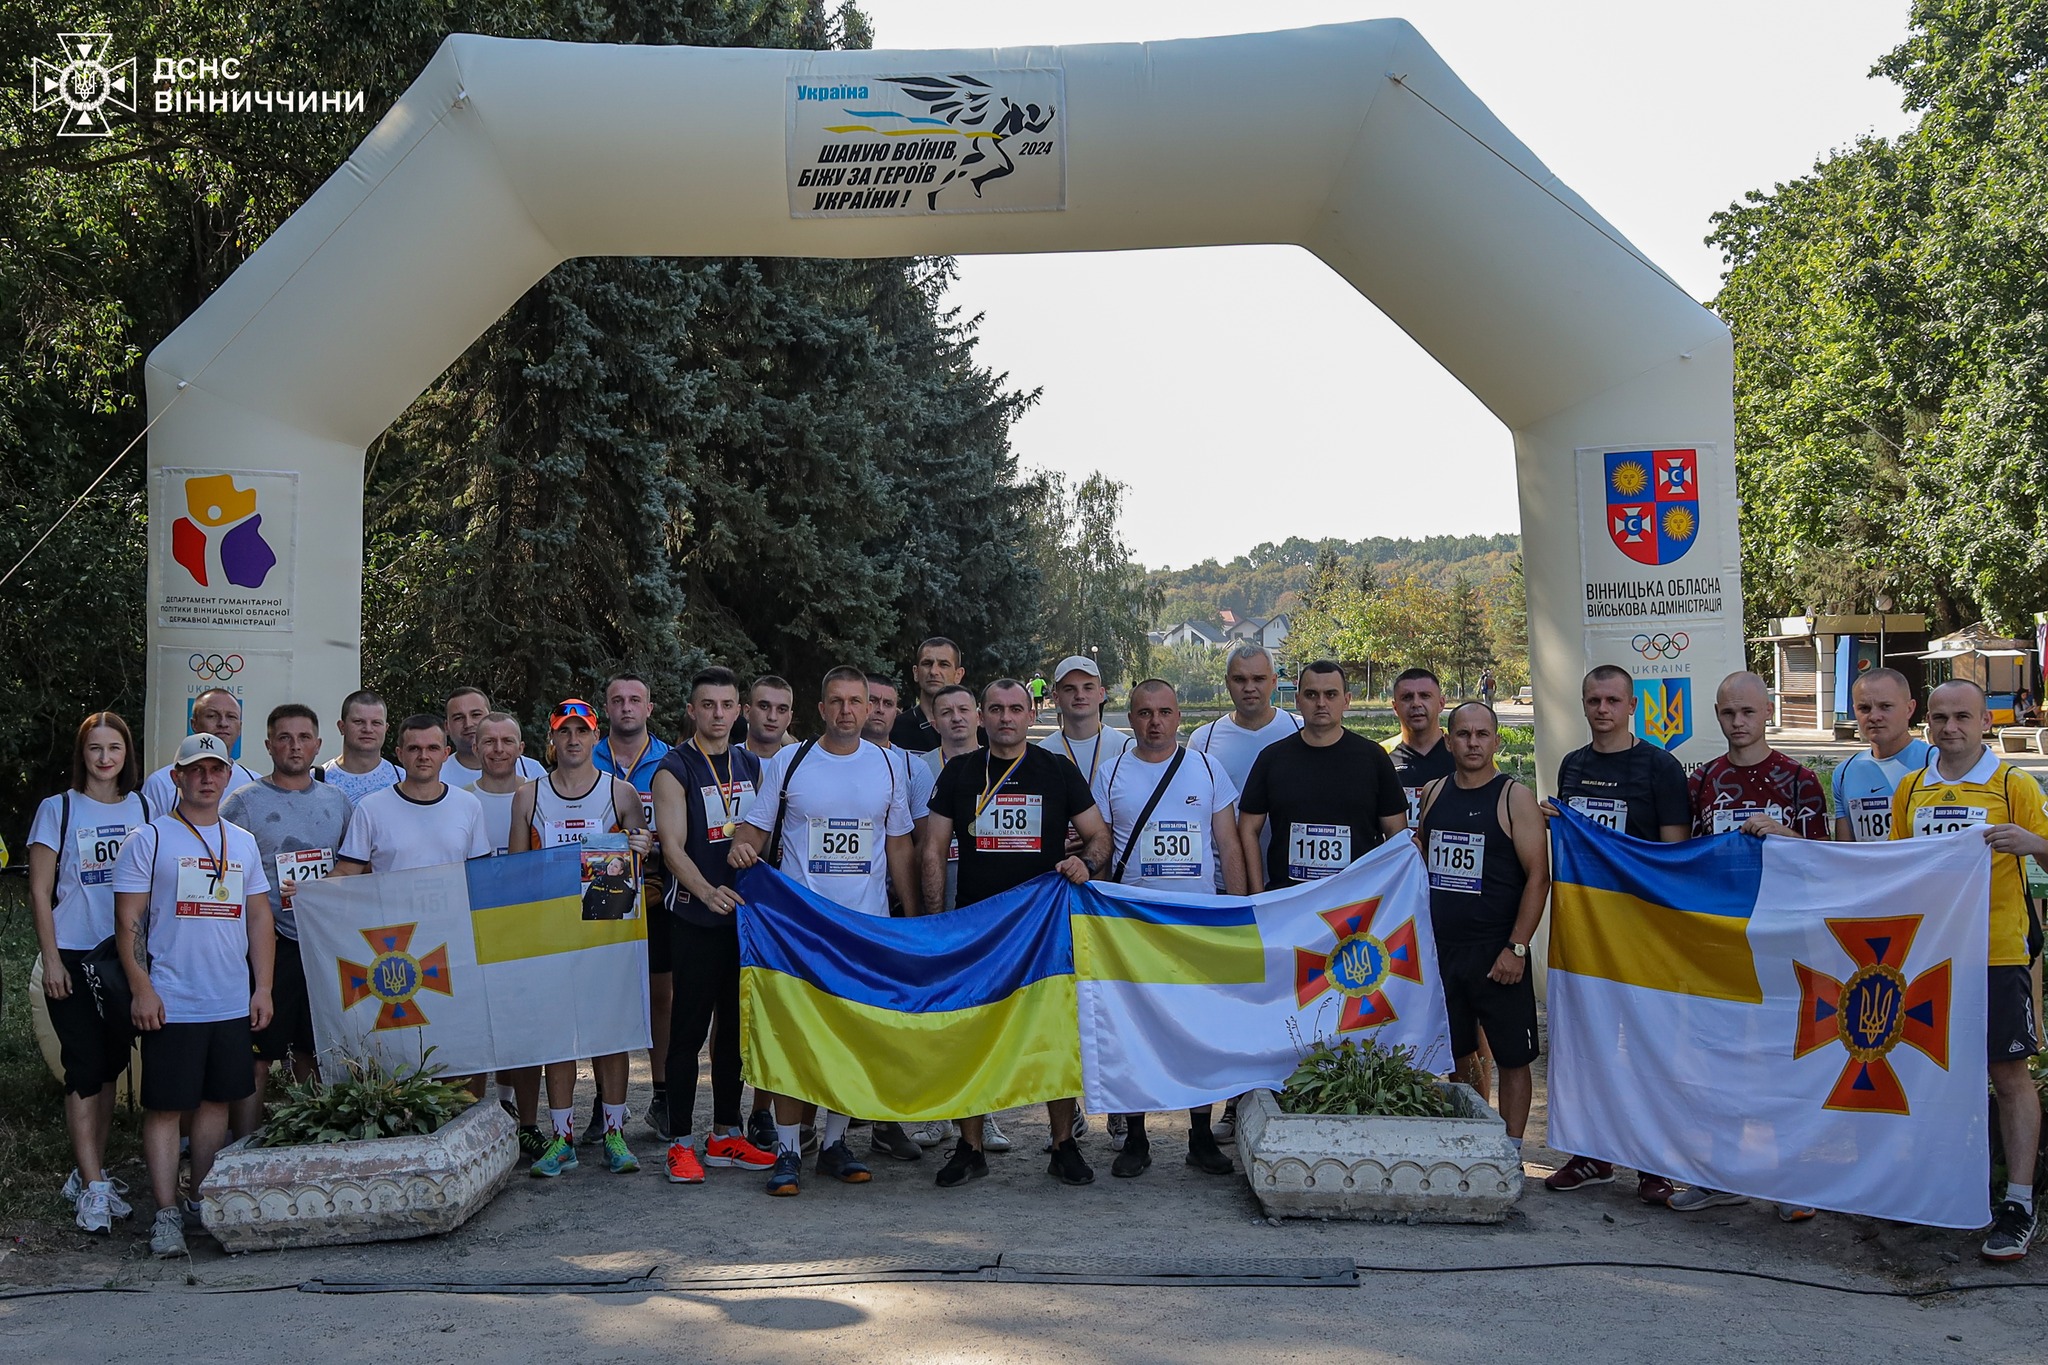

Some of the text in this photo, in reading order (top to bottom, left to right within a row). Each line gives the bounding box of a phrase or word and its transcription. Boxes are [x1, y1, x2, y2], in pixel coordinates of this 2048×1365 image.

[798, 85, 869, 101] Україна
[818, 138, 957, 164] ШАНУЮ ВОЇНІВ,
[1018, 141, 1053, 156] 2024
[797, 162, 937, 187] БІЖУ ЗА ГЕРОЇВ
[813, 187, 900, 210] УКРАЇНИ
[1586, 577, 1721, 600] ВІННИЦЬКА ОБЛАСНА
[161, 605, 290, 617] ПОЛІТИКИ ВІННИЦЬКОЇ ОБЛАСНОЇ
[166, 596, 282, 606] ДЕПАРТАМЕНТ ГУМАНІТАРНОЇ
[1587, 597, 1722, 617] ВІЙСЬКОВА АДМІНІСТРАЦІЯ
[169, 615, 276, 627] ДЕРЖАВНОЇ АДМІНІСТРАЦІЇ
[1632, 663, 1691, 674] UKRAINE
[187, 684, 243, 695] UKRNE
[990, 808, 1027, 830] 158
[94, 839, 122, 863] 60
[823, 832, 860, 854] 526
[1153, 834, 1190, 857] 530
[1296, 838, 1343, 861] 1183
[1433, 845, 1475, 870] 1185
[286, 863, 329, 881] 1215
